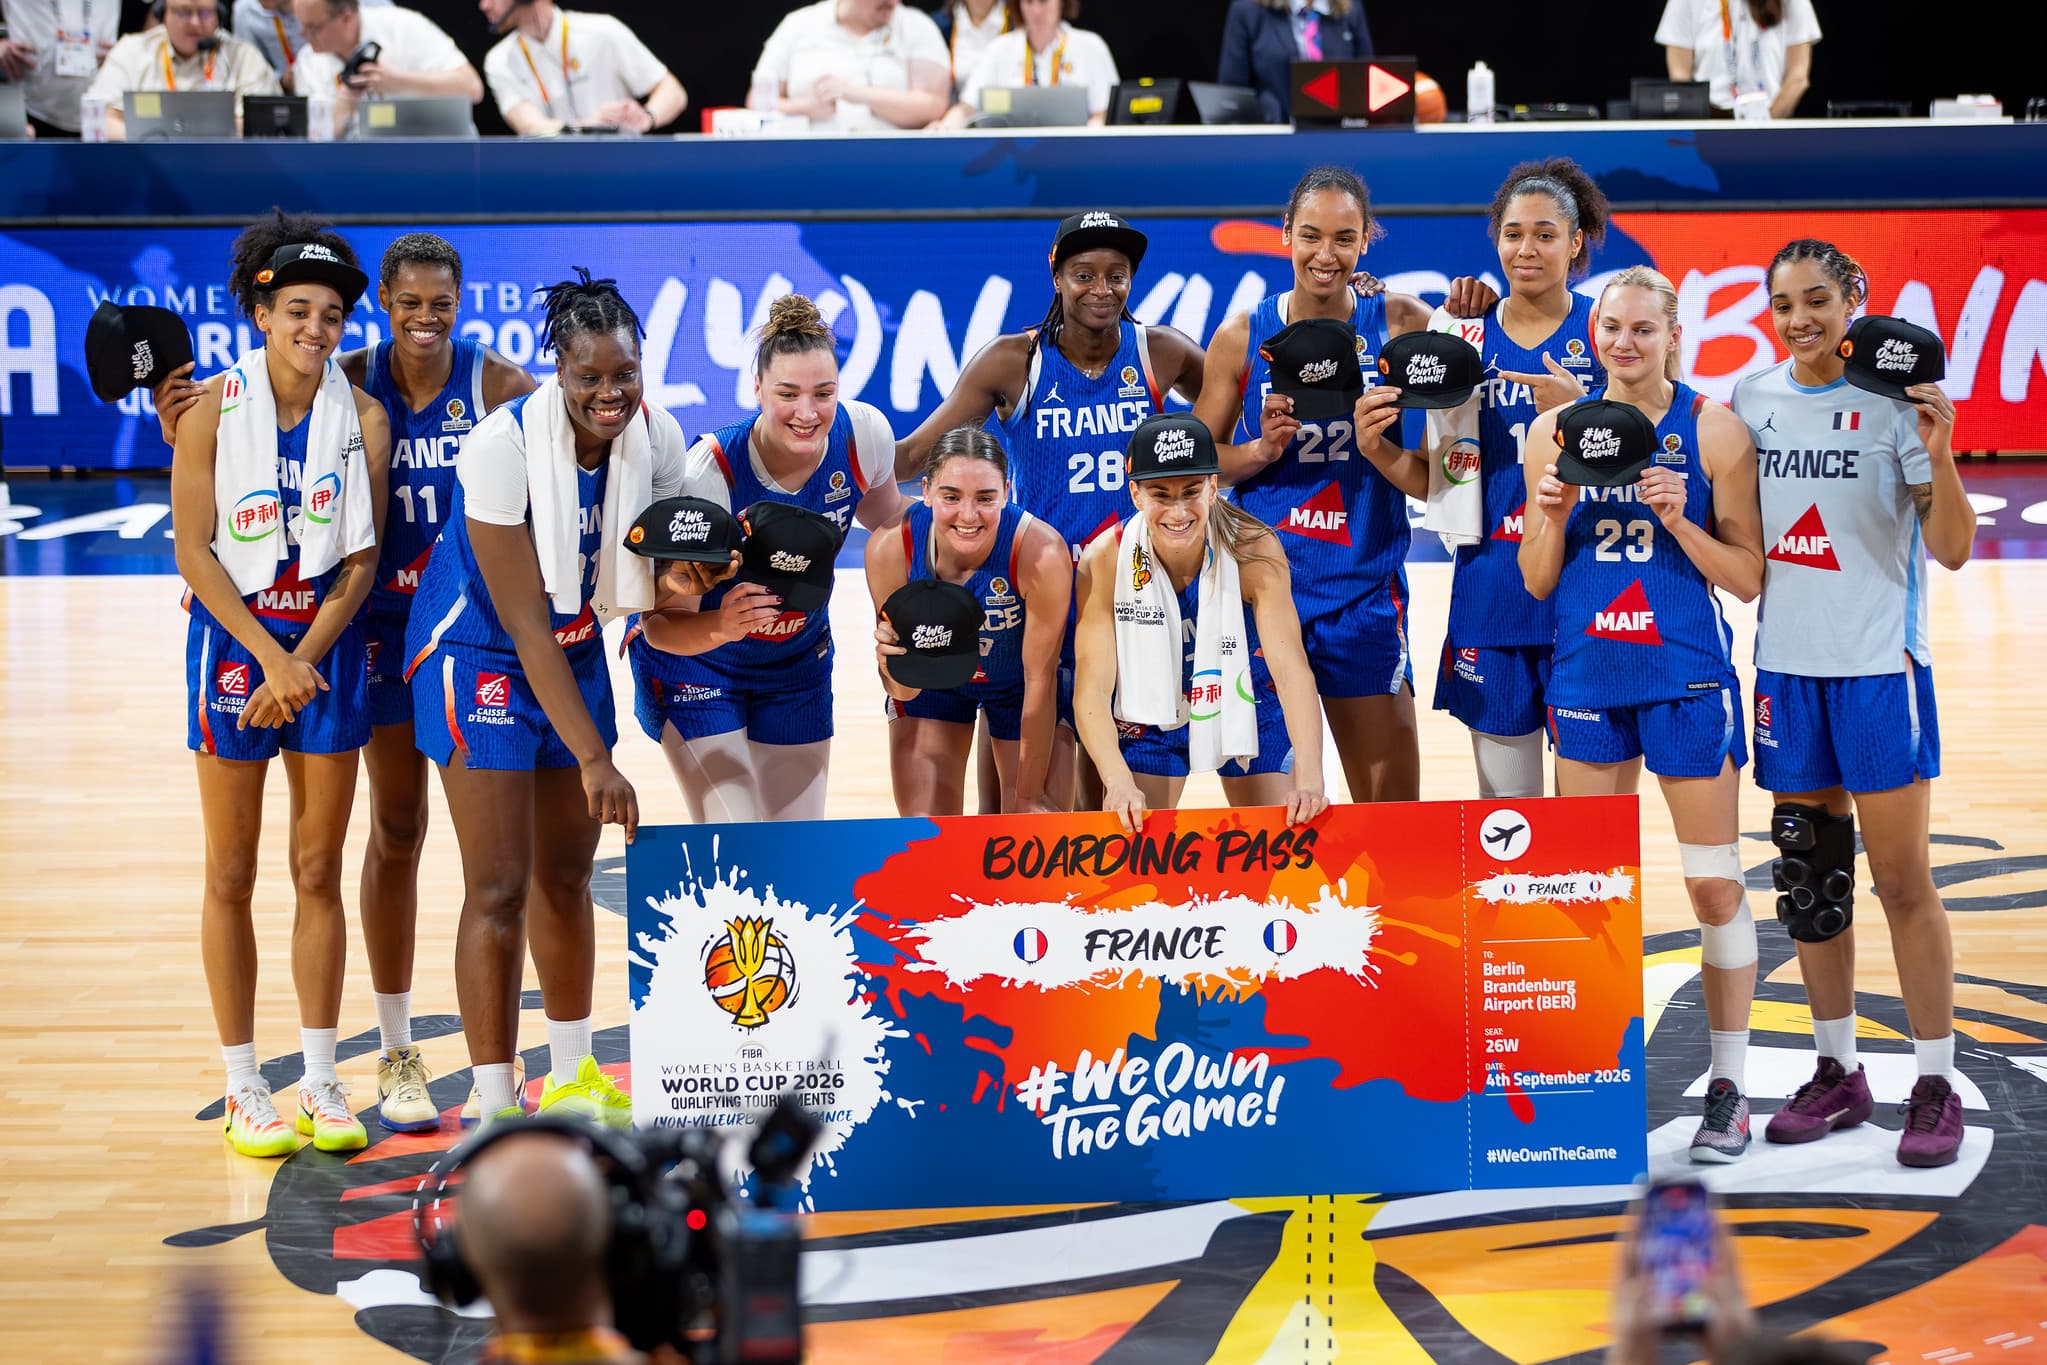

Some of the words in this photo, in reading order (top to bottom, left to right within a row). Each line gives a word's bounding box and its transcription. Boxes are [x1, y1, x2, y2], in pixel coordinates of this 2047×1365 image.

[1884, 338, 1914, 354] #We
[1410, 354, 1439, 368] #We
[1036, 400, 1150, 439] FRANCE
[1157, 429, 1186, 443] #We
[1296, 420, 1353, 463] 22
[1583, 427, 1613, 441] #We
[1068, 450, 1124, 493] 28
[1756, 448, 1859, 479] FRANCE
[395, 485, 437, 523] 11
[236, 500, 278, 531] 伊利
[673, 509, 704, 523] #We
[1289, 507, 1347, 530] MAIF
[1595, 519, 1654, 562] 23
[1778, 535, 1831, 556] MAIF
[257, 590, 316, 610] MAIF
[751, 616, 807, 635] MAIF
[1595, 611, 1654, 631] MAIF
[915, 624, 945, 637] #We
[210, 702, 245, 714] D'EPARG
[218, 696, 246, 706] CAISSE
[468, 714, 515, 725] D'EPARGNE
[476, 707, 507, 717] CAISSE
[1557, 708, 1601, 722] D'EPARGNE
[982, 831, 1205, 881] BOARDING
[1216, 828, 1319, 873] PASS
[1528, 882, 1577, 895] FRANCE
[1084, 925, 1227, 962] FRANCE
[1483, 951, 1494, 959] TO:
[1483, 962, 1525, 976] Berlin
[1483, 978, 1576, 994] Brandenburg
[1483, 996, 1534, 1014] Airport
[1536, 993, 1577, 1011] (BER)
[1484, 1028, 1504, 1036] SEAT:
[742, 1048, 762, 1059] FIBA
[1485, 1038, 1519, 1053] 26W
[661, 1063, 737, 1075] WOMEN'S
[743, 1059, 845, 1073] BASKETBALL
[1485, 1062, 1505, 1071] DATE:
[662, 1077, 739, 1094] WORLD
[746, 1075, 787, 1091] CUP
[793, 1073, 845, 1090] 2026
[1485, 1072, 1510, 1087] 4th
[1514, 1070, 1591, 1088] September
[1594, 1069, 1631, 1083] 2026
[671, 1095, 741, 1110] QUALIFYING
[744, 1092, 836, 1108] TOURNMENTS
[1486, 1145, 1617, 1163] #WeOwnTheGame
